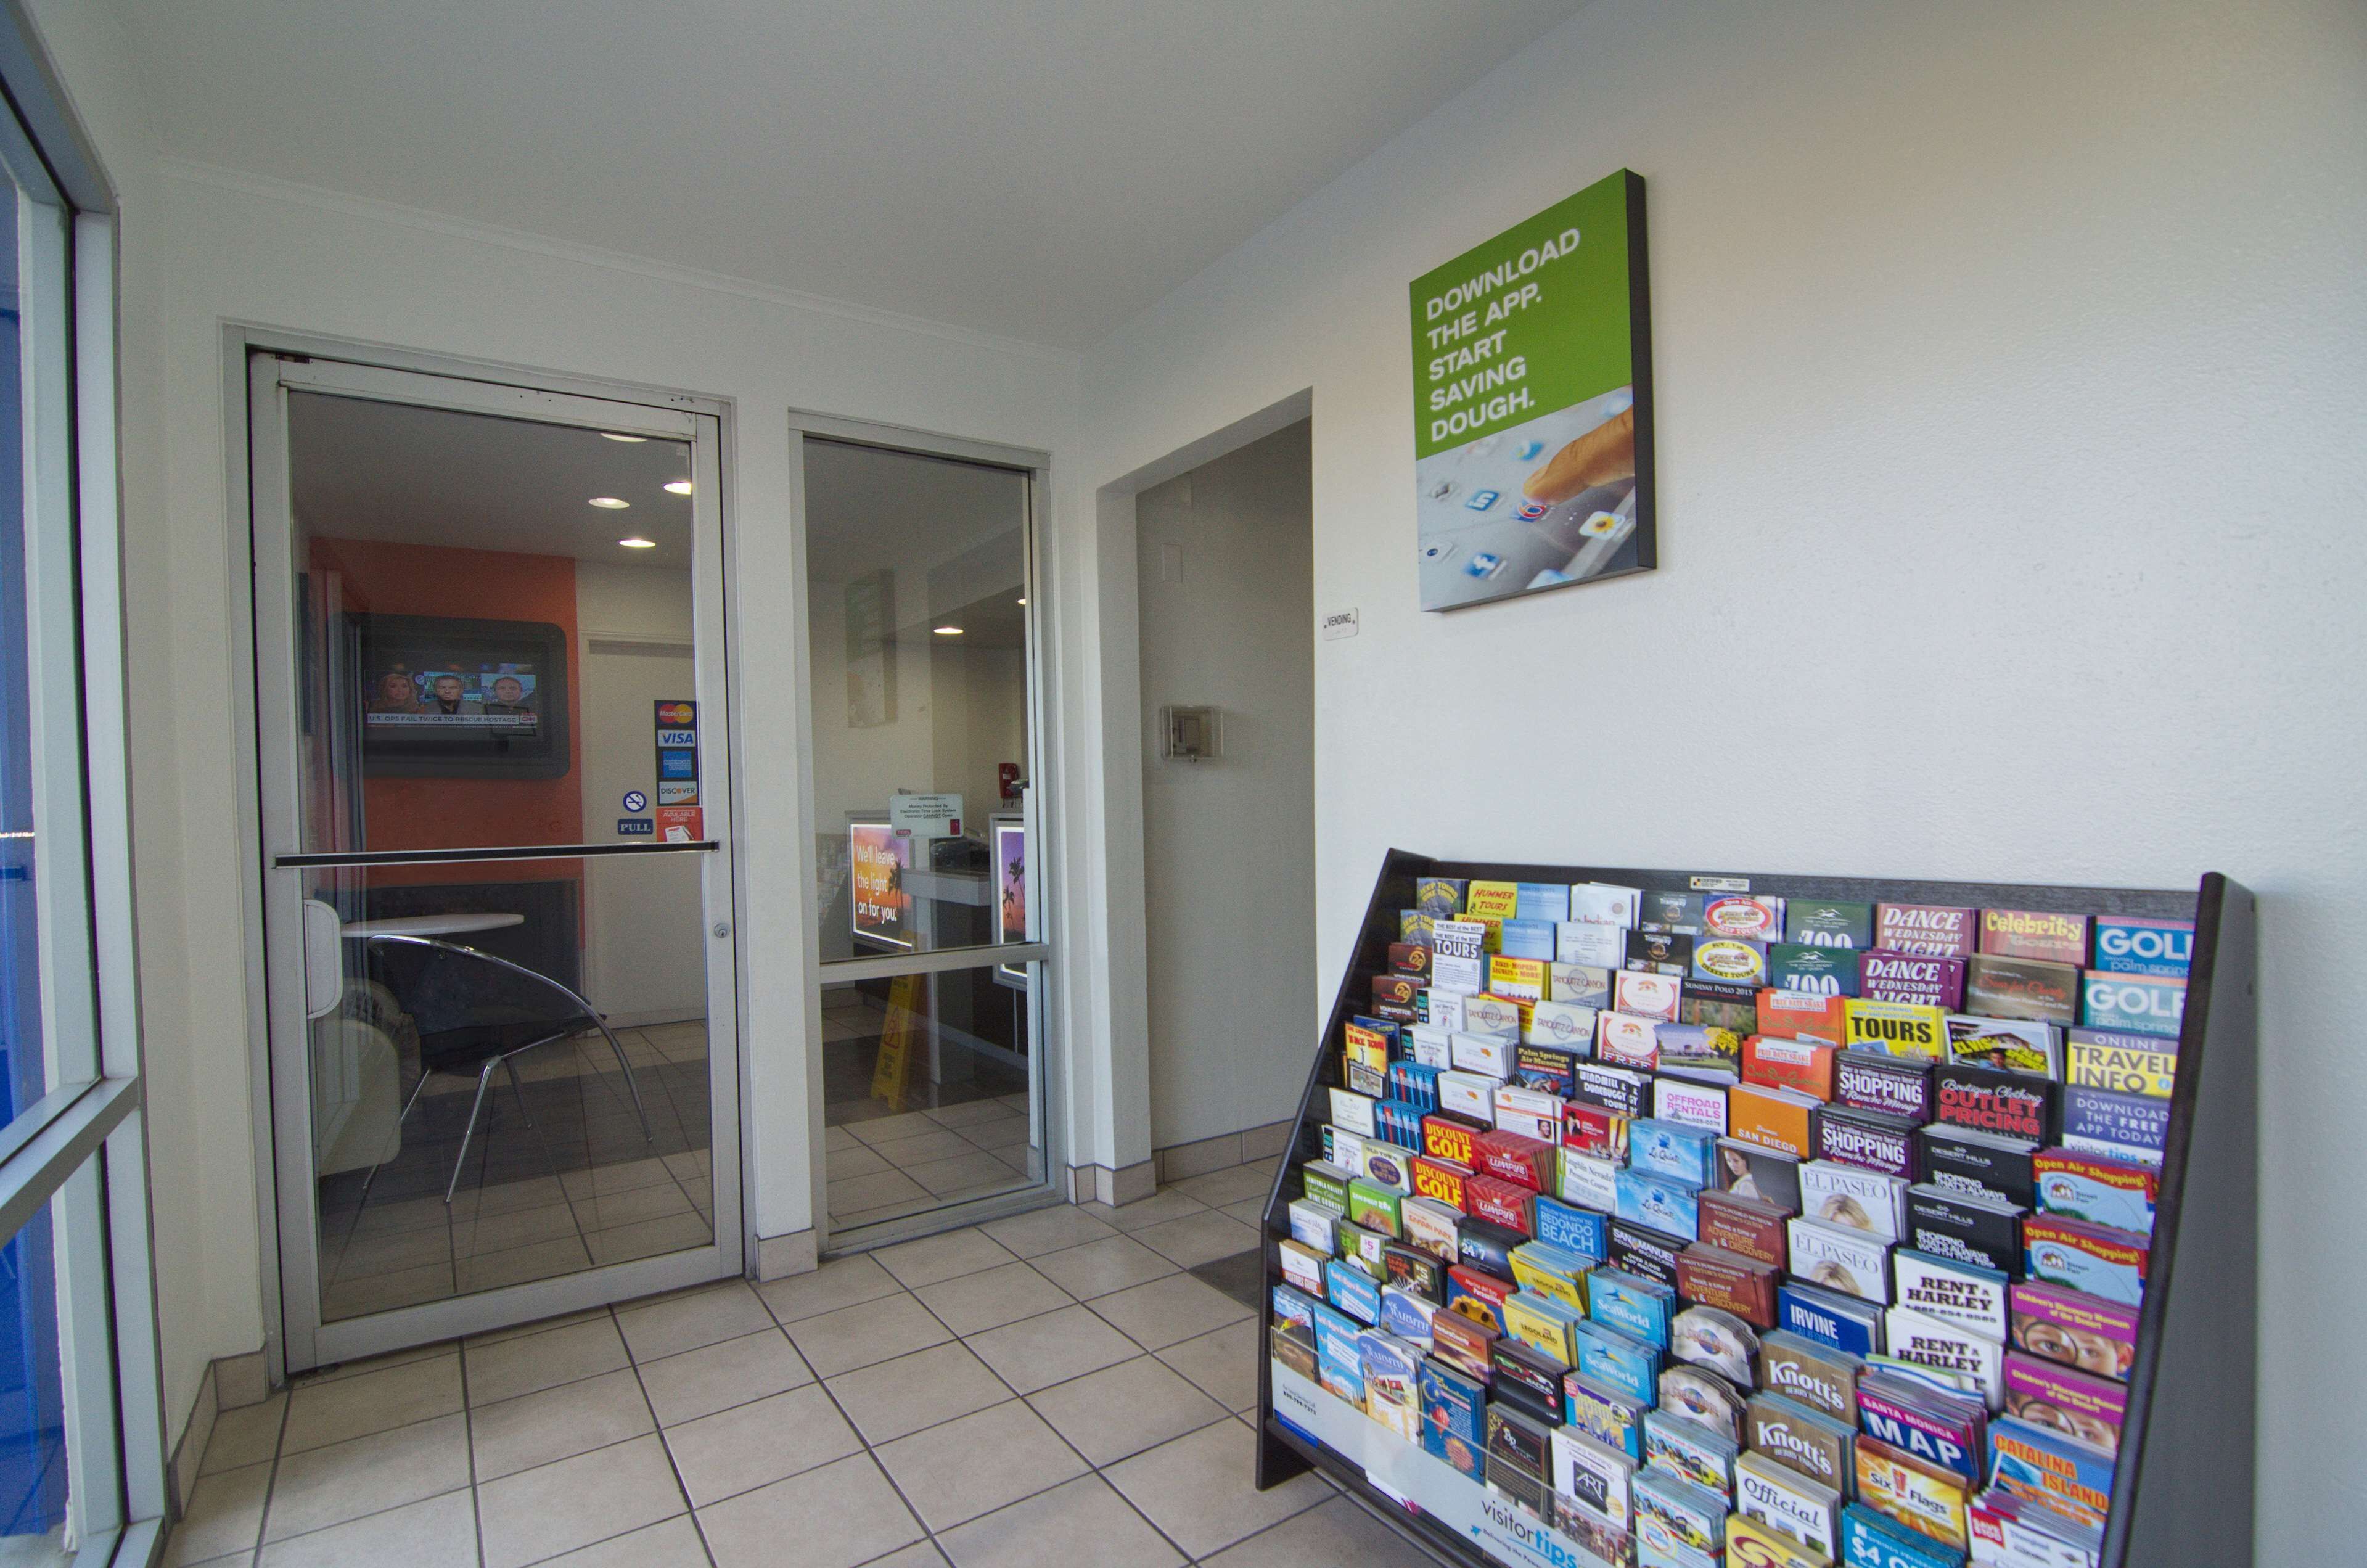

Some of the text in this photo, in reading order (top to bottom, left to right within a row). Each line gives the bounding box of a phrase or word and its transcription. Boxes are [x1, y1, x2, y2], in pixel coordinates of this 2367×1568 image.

[1427, 228, 1580, 321] DOWNLOAD
[1428, 283, 1543, 350] THE APP.
[1429, 330, 1506, 380] START
[1430, 356, 1527, 411] SAVING
[1431, 388, 1535, 443] DOUGH.
[1327, 613, 1351, 626] VENDING
[662, 733, 694, 744] VISA
[620, 823, 651, 832] PULL
[856, 845, 895, 865] We'll leave
[857, 873, 887, 896] the light
[1474, 889, 1514, 900] HUMMER
[858, 903, 867, 916] on
[868, 898, 879, 917] for
[1480, 901, 1508, 911] TOURS
[1884, 908, 1963, 930] DANCE
[1986, 911, 2082, 942] Celebrity
[1468, 935, 1480, 943] BEST
[1883, 928, 1963, 943] WEDNESDAY
[1887, 939, 1960, 957] NIGHT
[1435, 940, 1477, 959] TOURS
[1866, 958, 1940, 982] DANCE
[1684, 981, 1753, 996] SUNDAY POLO 2015
[1867, 979, 1943, 994] WEDNESDAY
[1872, 990, 1942, 1006] NIGHT
[1772, 998, 1826, 1009] FREE DATE SHAKE
[2086, 983, 2186, 1018] GOLF
[1852, 1017, 1932, 1043] TOURS
[1519, 1048, 1570, 1062] Palm Springs
[1757, 1048, 1810, 1061] FREE DATE SHAKE
[2095, 1035, 2159, 1051] ONLINE
[1521, 1055, 1567, 1069] Air Museum
[1604, 1051, 1651, 1069] FREE
[2072, 1046, 2175, 1076] TRAVEL
[1584, 1082, 1627, 1102] DUNEBUGGY
[1839, 1072, 1923, 1104] SHOPPING
[2077, 1066, 2146, 1093] INFO
[1604, 1098, 1627, 1110] TOURS
[1667, 1093, 1721, 1110] OFFROAD
[1939, 1089, 2038, 1118] OUTLET
[1941, 1078, 2043, 1107] Boutique Clothing
[1667, 1102, 1721, 1119] RENTALS
[1939, 1104, 2040, 1136] PRICING
[2076, 1098, 2169, 1122] DOWNLOAD
[2086, 1111, 2159, 1133] THE FREE
[1426, 1122, 1471, 1146] DISCOUNT
[1738, 1128, 1798, 1154] SAN DIEGO
[1821, 1128, 1905, 1164] SHOPPING
[2076, 1122, 2162, 1146] APP TODAY
[1427, 1136, 1472, 1164] GOLF
[1931, 1146, 1992, 1166] DESERT HILLS
[1416, 1161, 1461, 1187] DISCOUNT
[1933, 1169, 1983, 1189] SHOPPING
[2035, 1159, 2147, 1188] Open Air Shopping!
[1417, 1175, 1462, 1207] GOLF
[1805, 1172, 1887, 1201] EL PASEO
[1541, 1210, 1593, 1237] REDONDO
[1914, 1204, 1974, 1225] DESERT HILLS
[1541, 1222, 1594, 1253] BEACH
[1613, 1228, 1675, 1263] SAN MANUEL
[1707, 1225, 1755, 1249] ADVENTURE
[2025, 1228, 2141, 1263] Open Air Shopping!
[1795, 1233, 1878, 1274] EL PASEO
[1622, 1255, 1667, 1280] SLOT MACHINES
[1684, 1281, 1731, 1302] ADVENTURE
[1907, 1287, 1993, 1311] HARLEY
[1921, 1276, 1990, 1297] RENT A
[1598, 1299, 1650, 1328] SeaWorld
[1790, 1303, 1839, 1340] IRVINE
[2016, 1291, 2130, 1329] Children's Discovery Museum
[2059, 1311, 2074, 1321] the
[2074, 1315, 2102, 1330] Desert
[1520, 1323, 1557, 1345] LEGOLAND
[1911, 1337, 1980, 1357] RENT A
[1586, 1354, 1638, 1387] SeaWorld
[1898, 1348, 1983, 1373] HARLEY
[1768, 1360, 1845, 1411] Knott's
[2012, 1369, 2124, 1413] Children's Discovery Museum
[1863, 1397, 1955, 1441] SANTA MONICA
[1757, 1421, 1833, 1476] Knott's
[1868, 1411, 1962, 1469] MAP
[1995, 1434, 2078, 1480] CATALINA
[1744, 1477, 1820, 1527] Official
[1871, 1472, 1948, 1514] Six Flags
[2041, 1472, 2109, 1513] ISLAND
[1481, 1499, 1577, 1568] visitortips
[1483, 1529, 1522, 1557] Delivering the
